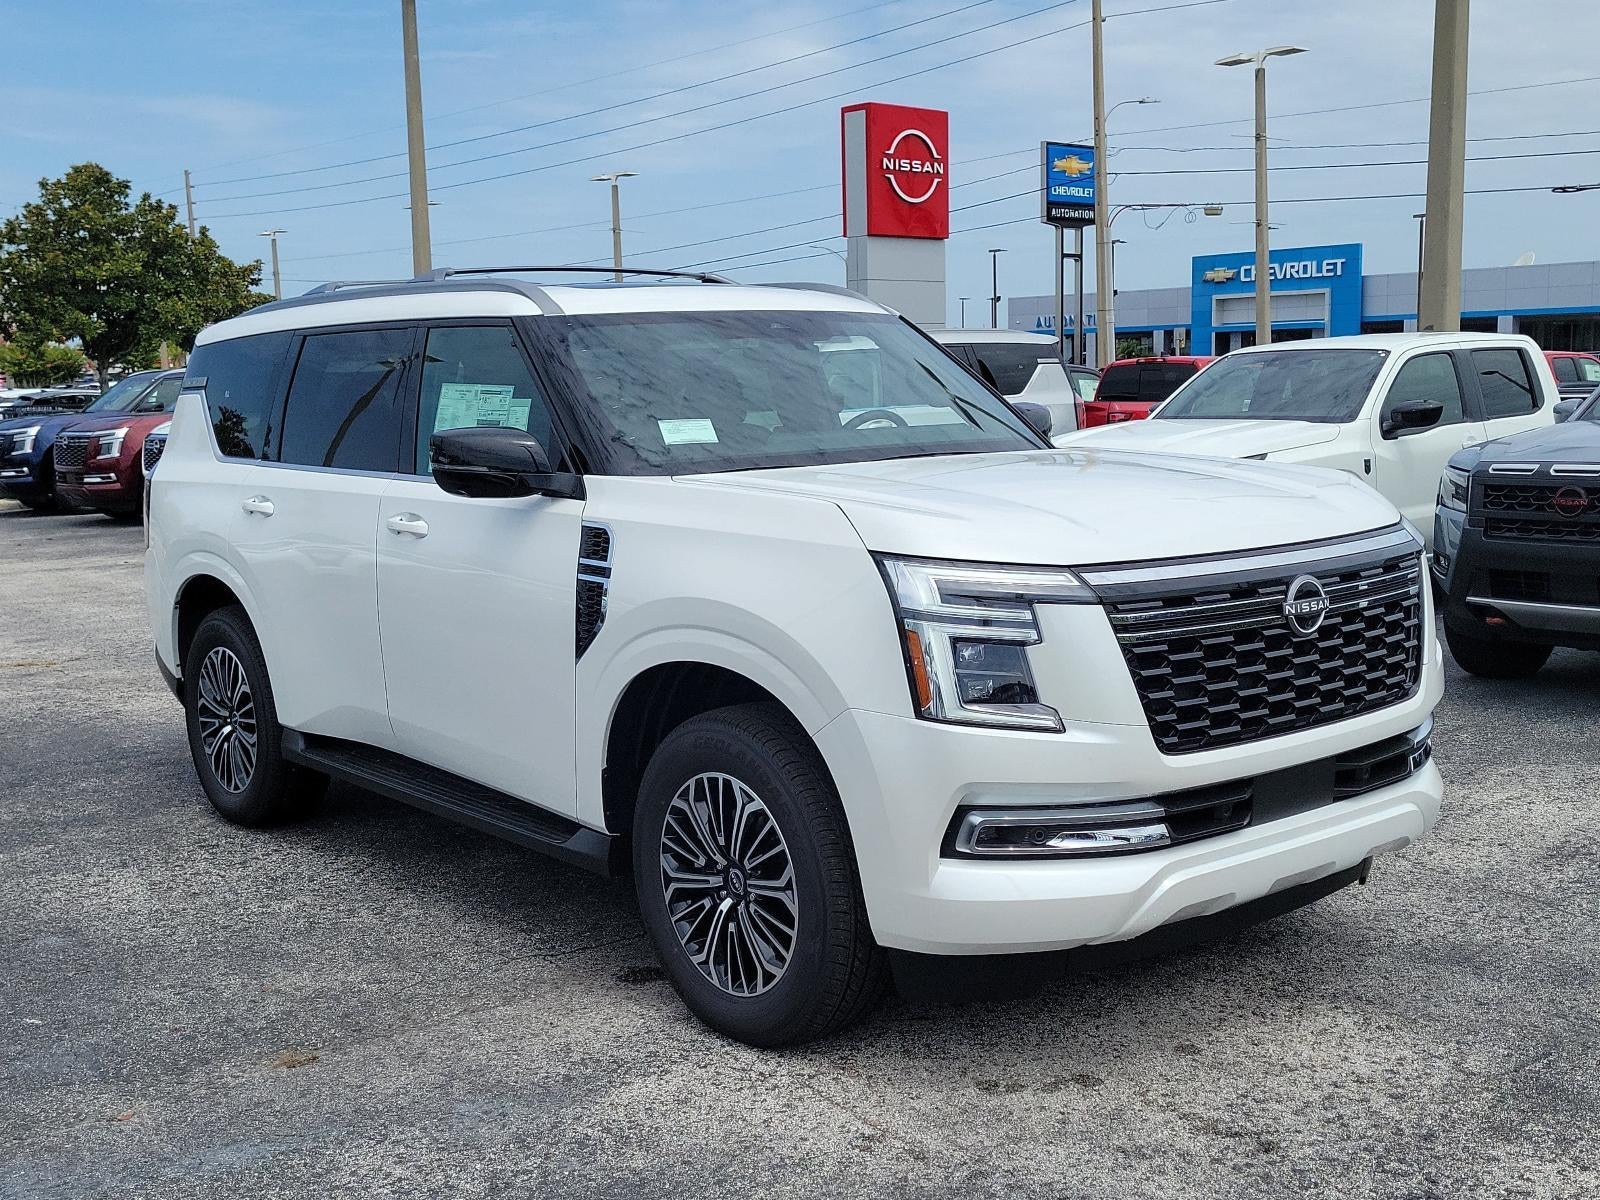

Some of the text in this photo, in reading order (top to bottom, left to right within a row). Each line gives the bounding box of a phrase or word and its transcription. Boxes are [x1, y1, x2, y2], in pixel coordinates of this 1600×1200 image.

[882, 157, 944, 174] NISSAN
[1051, 186, 1094, 198] CHEVROLET
[1051, 208, 1095, 219] AUTONATION
[1240, 258, 1346, 282] CEVROLET
[1285, 598, 1330, 615] NISSAN
